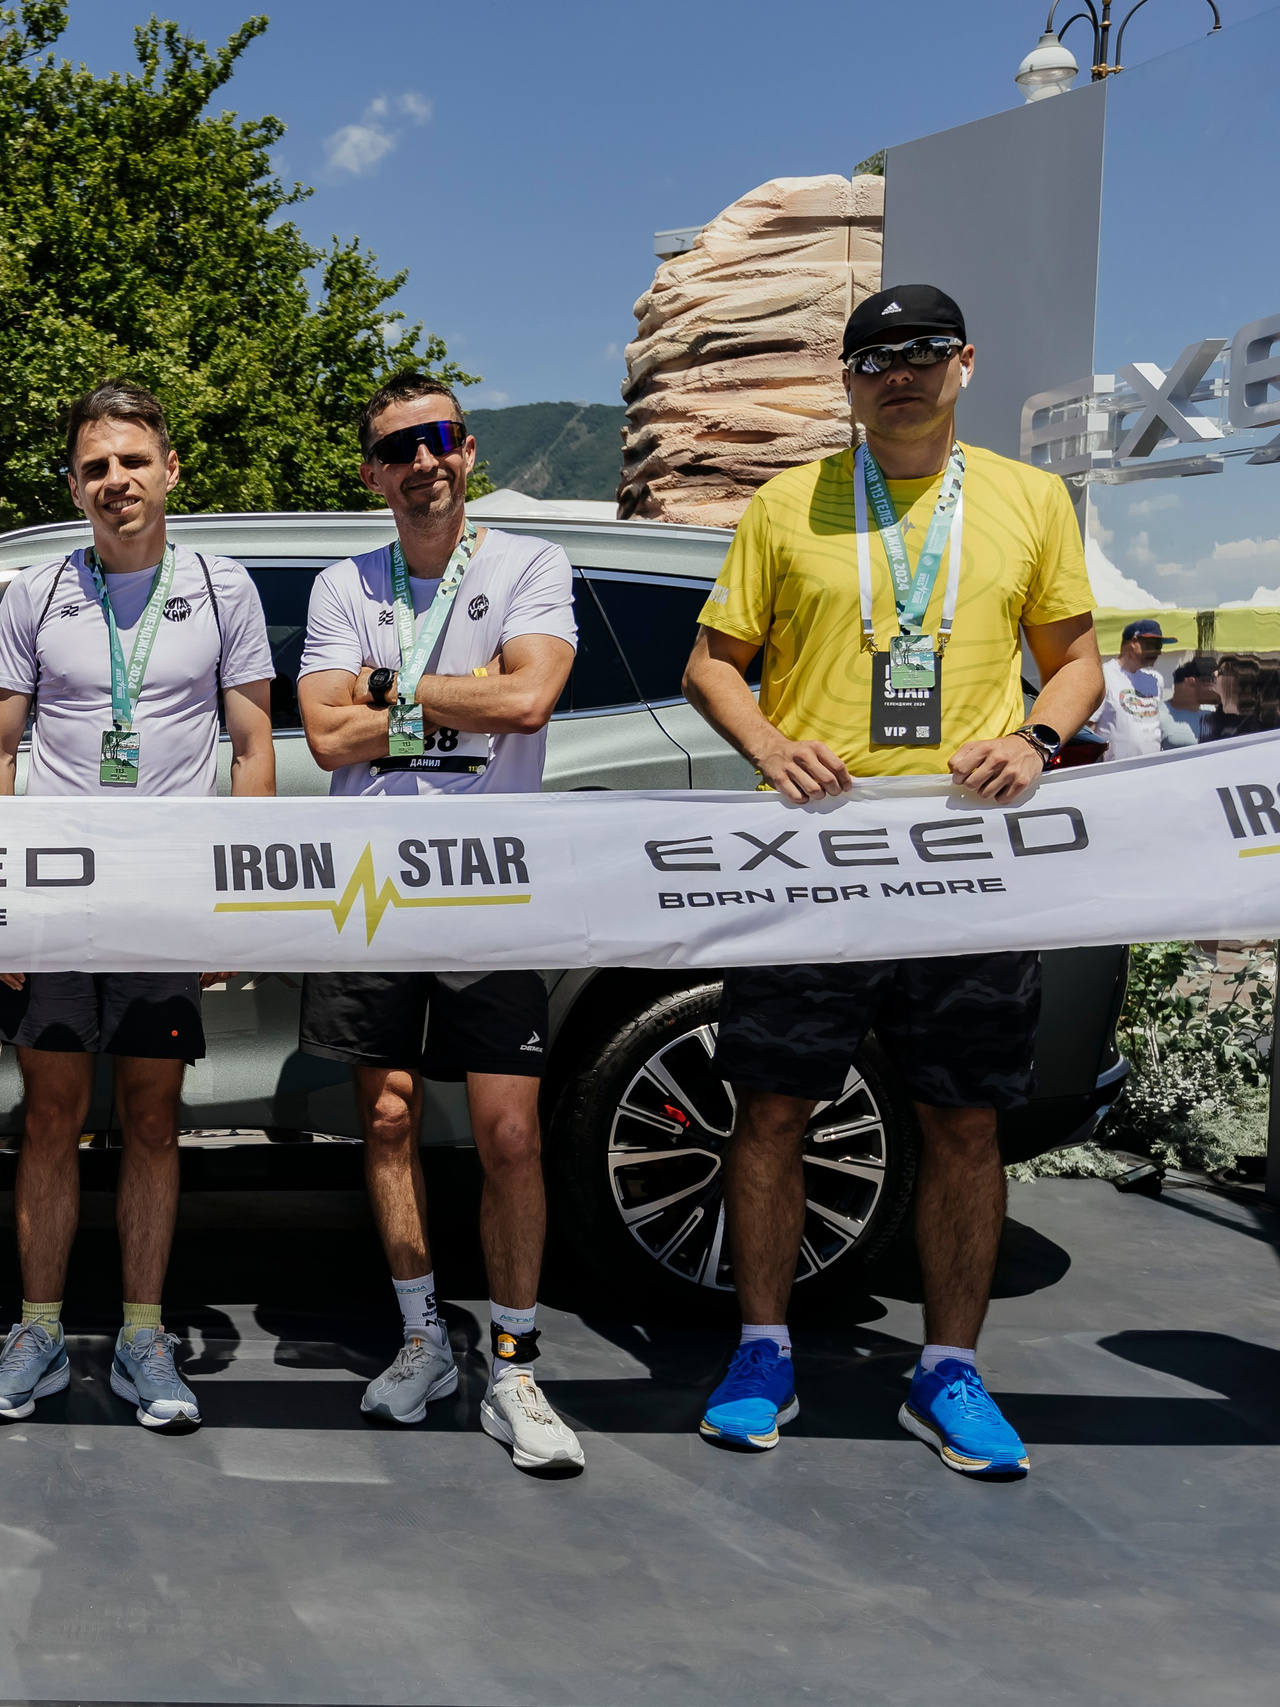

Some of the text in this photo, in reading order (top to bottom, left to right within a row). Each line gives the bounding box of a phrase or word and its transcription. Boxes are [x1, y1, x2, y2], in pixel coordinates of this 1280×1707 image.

[870, 481, 885, 498] 113
[875, 496, 901, 562] ГЕЛЕНДЖИК
[395, 576, 406, 591] 113
[893, 563, 910, 591] 2024
[152, 582, 167, 600] 113
[134, 602, 162, 661] ГЕЛЕНДЖИК
[128, 664, 143, 689] 2024
[884, 727, 907, 737] VIP
[410, 758, 440, 768] ДАНИЛ
[1216, 782, 1280, 839] IR
[644, 806, 1090, 871] EXEED
[213, 836, 530, 892] IRON STAR
[658, 877, 1007, 909] BORN FOR MORE
[499, 1314, 534, 1323] ASTAN
